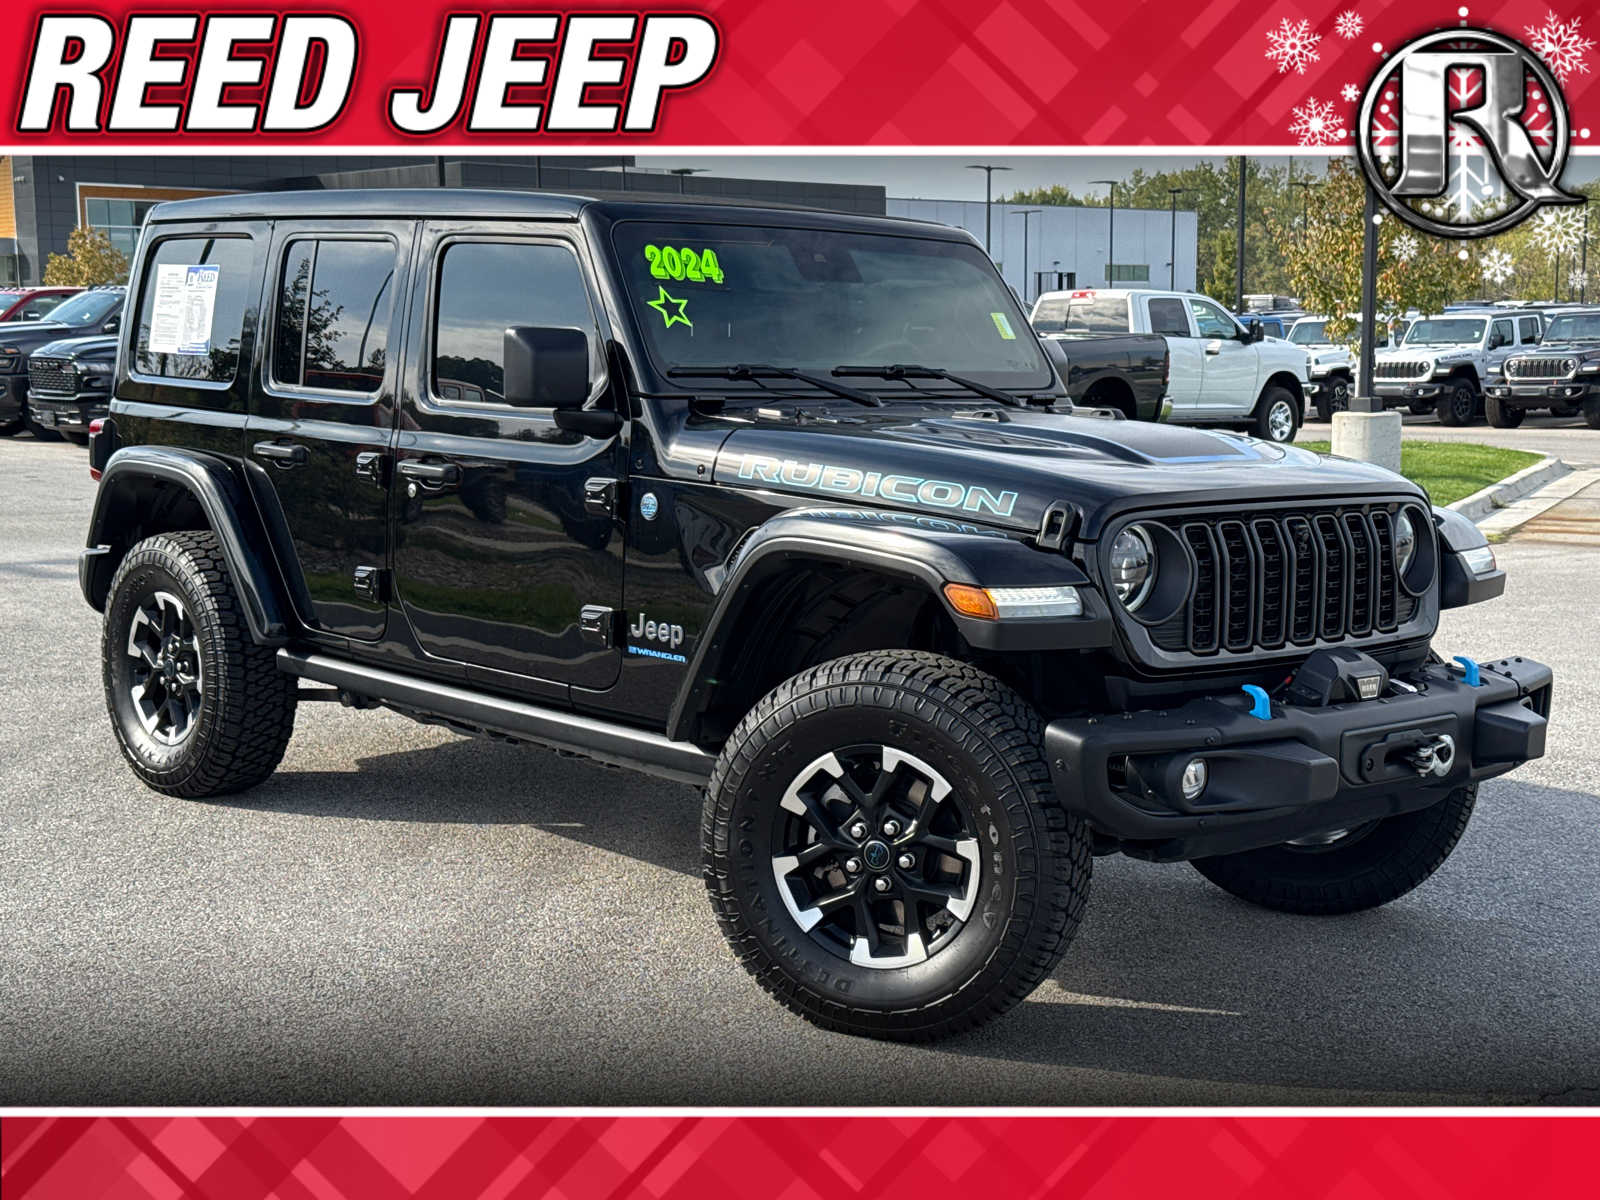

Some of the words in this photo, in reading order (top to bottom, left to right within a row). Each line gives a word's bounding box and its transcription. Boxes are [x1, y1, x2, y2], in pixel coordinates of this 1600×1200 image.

[644, 244, 725, 285] 2024
[737, 453, 1019, 518] RUBICON
[630, 612, 685, 649] Jeep
